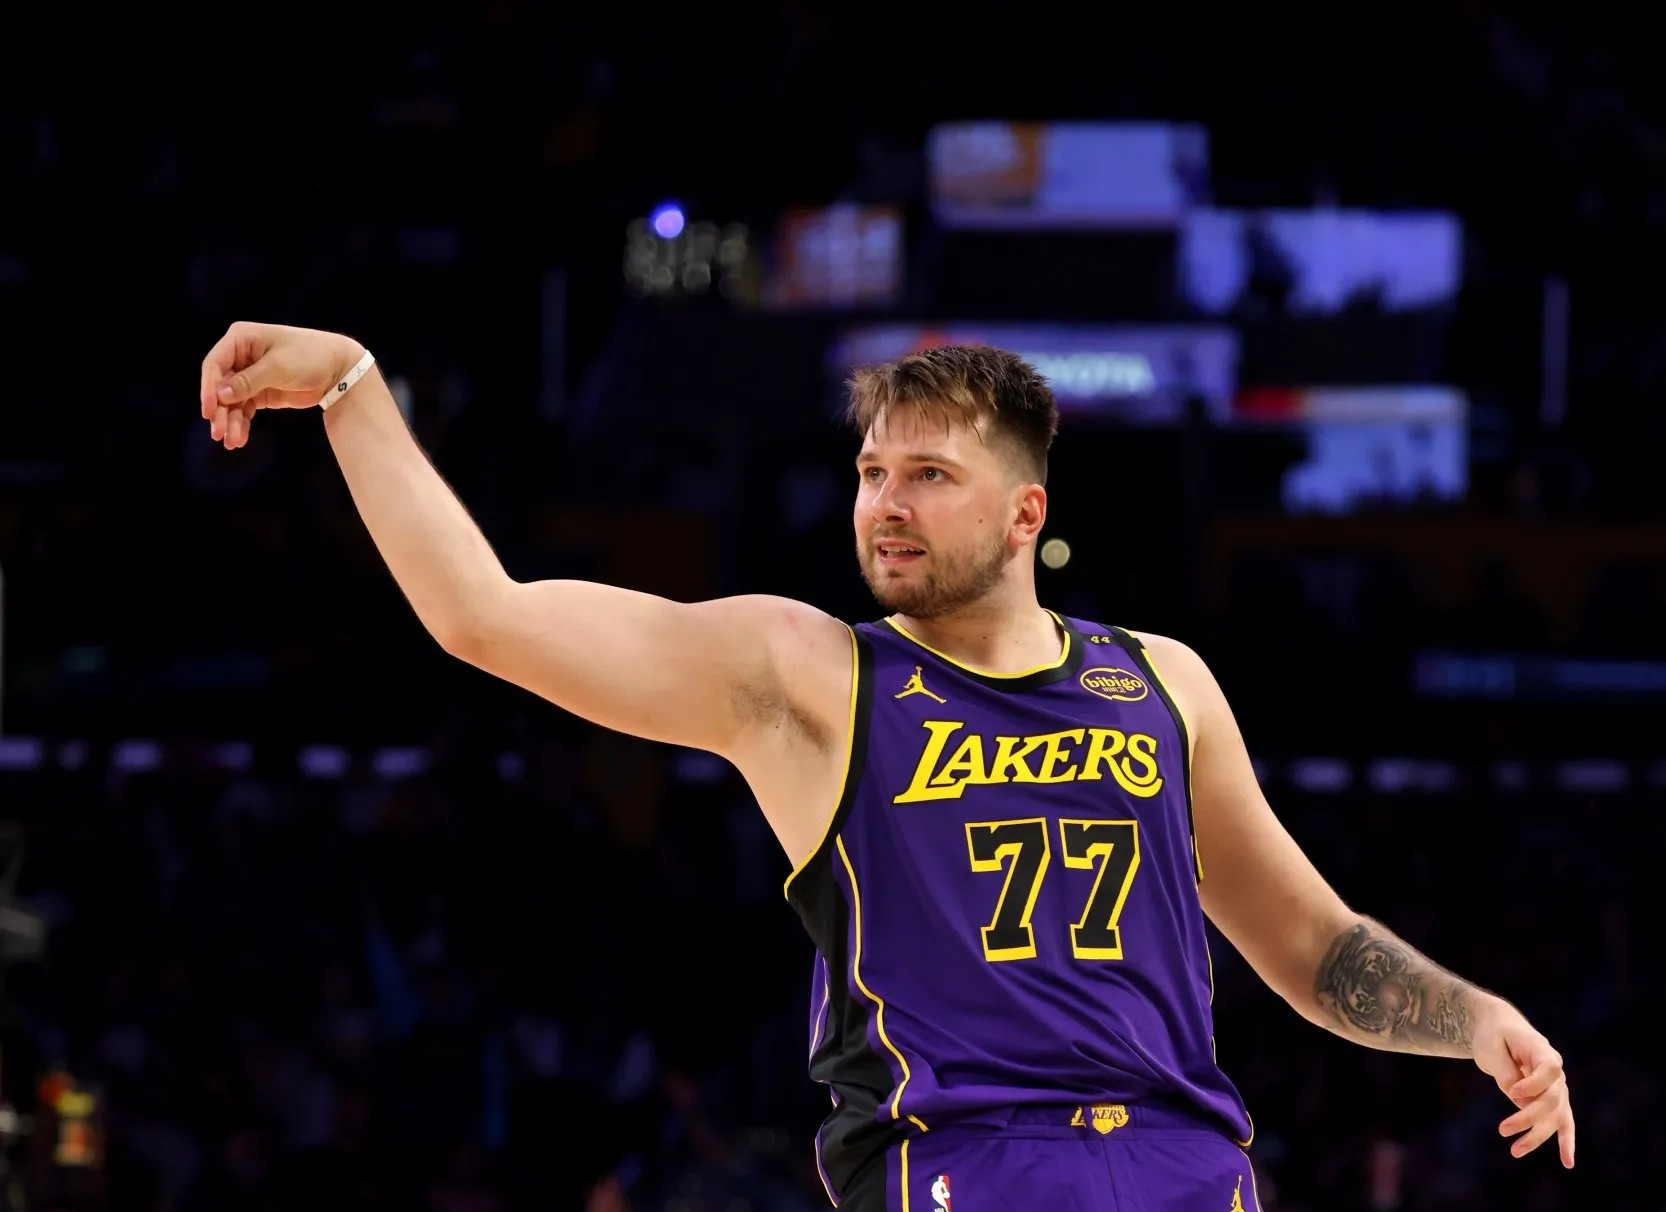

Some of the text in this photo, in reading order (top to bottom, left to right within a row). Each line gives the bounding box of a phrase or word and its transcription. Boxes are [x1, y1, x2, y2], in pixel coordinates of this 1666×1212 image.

[1090, 635, 1111, 644] 44
[1085, 675, 1142, 691] bibigo
[892, 720, 1164, 804] LAKERS
[964, 816, 1142, 962] 77
